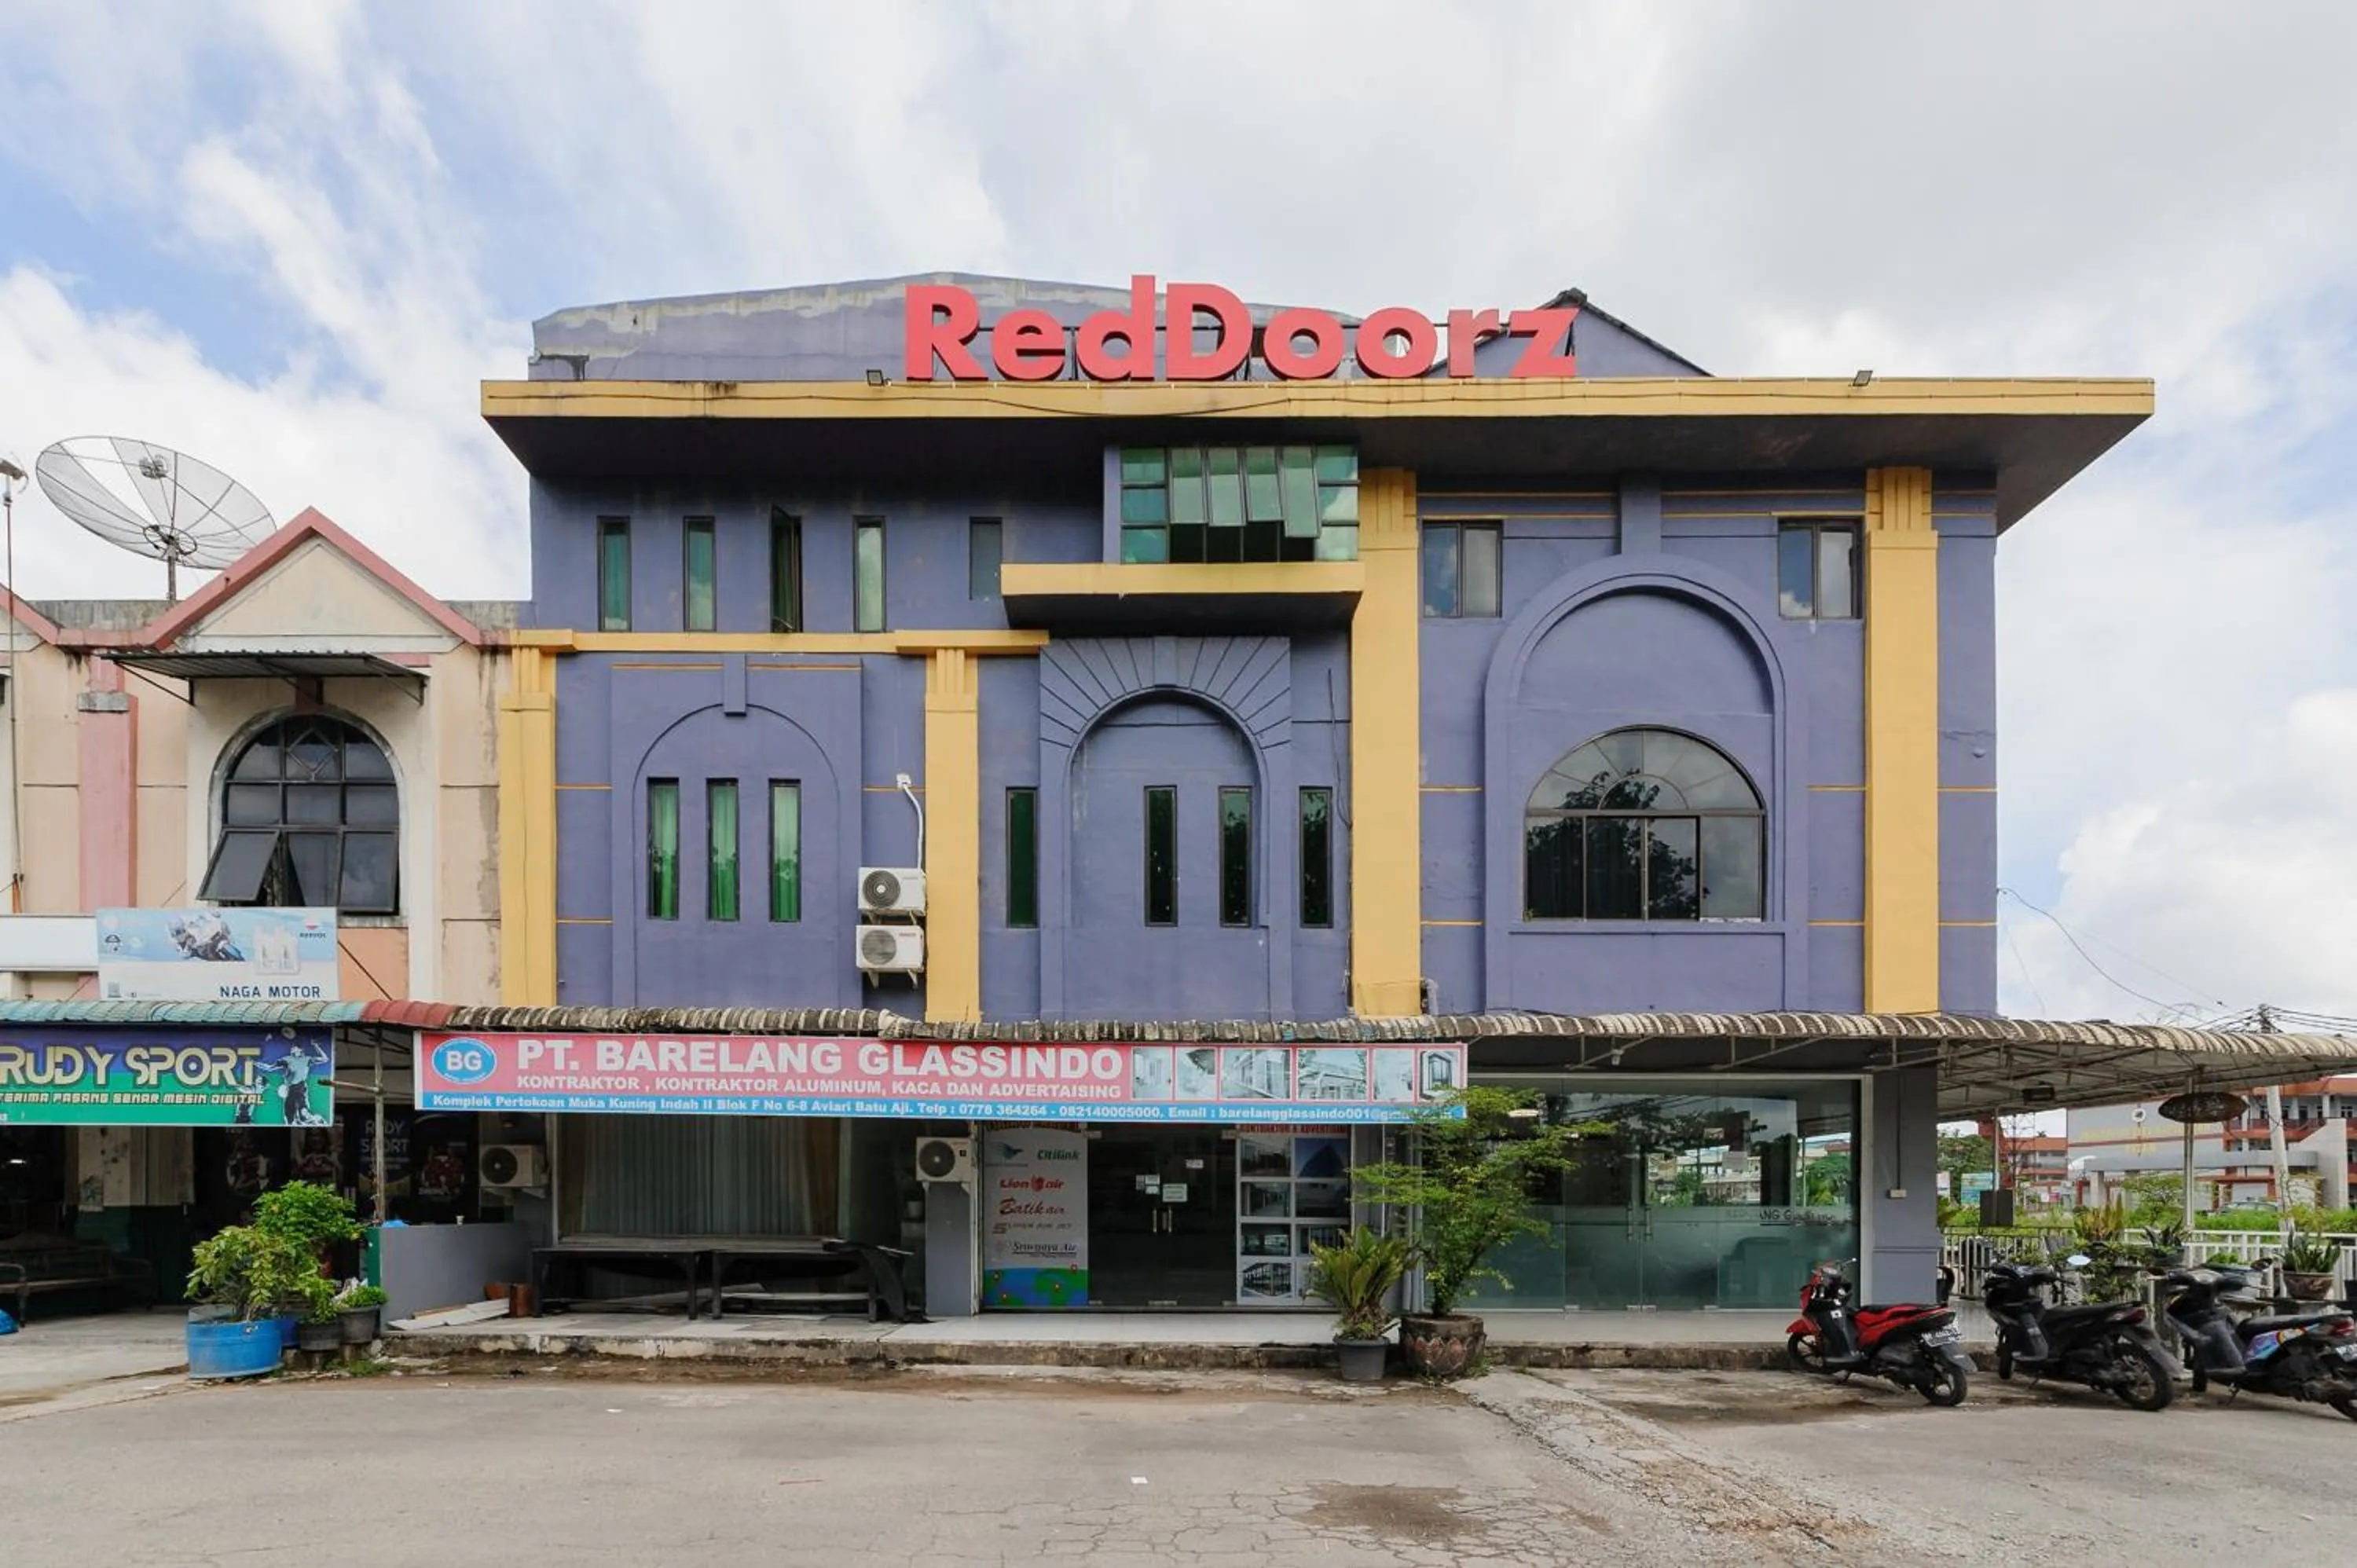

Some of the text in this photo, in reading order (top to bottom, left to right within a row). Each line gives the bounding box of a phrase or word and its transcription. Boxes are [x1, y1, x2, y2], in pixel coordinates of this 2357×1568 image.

[905, 275, 1579, 381] RedDoorz
[220, 986, 321, 998] NAGA MOTOR
[0, 1046, 261, 1086] RUDY SPORT
[446, 1050, 482, 1071] BG
[517, 1039, 580, 1071] PT.
[596, 1040, 841, 1075] BARELANG
[858, 1043, 1123, 1080] GLASSINDO
[517, 1075, 640, 1090] KONTRAKTOR
[655, 1077, 778, 1092] KONTRAKTOR
[783, 1079, 886, 1096] ALUMINUM,
[893, 1081, 940, 1094] KACA
[947, 1082, 984, 1096] DAN
[988, 1083, 1121, 1098] ADVERTAISING
[53, 1093, 109, 1104] PASANG
[113, 1093, 158, 1104] SENAR
[163, 1094, 207, 1104] MESIN
[211, 1094, 264, 1104] DIGITAL
[433, 1095, 490, 1108] Komplek
[496, 1097, 565, 1108] Pertokoan
[569, 1097, 605, 1108] Muka
[610, 1098, 655, 1112] Kuning
[661, 1099, 698, 1110] Indah
[717, 1100, 746, 1110] Blok
[751, 1101, 760, 1109] F
[764, 1101, 783, 1111] No
[786, 1101, 808, 1111] 6-8
[812, 1101, 851, 1112] Aviari
[855, 1101, 886, 1113] Batu
[918, 1103, 947, 1116] Telp
[959, 1103, 992, 1115] 0778
[1168, 1107, 1206, 1118] Email
[365, 1119, 405, 1135] RDY
[361, 1138, 409, 1153] SORT
